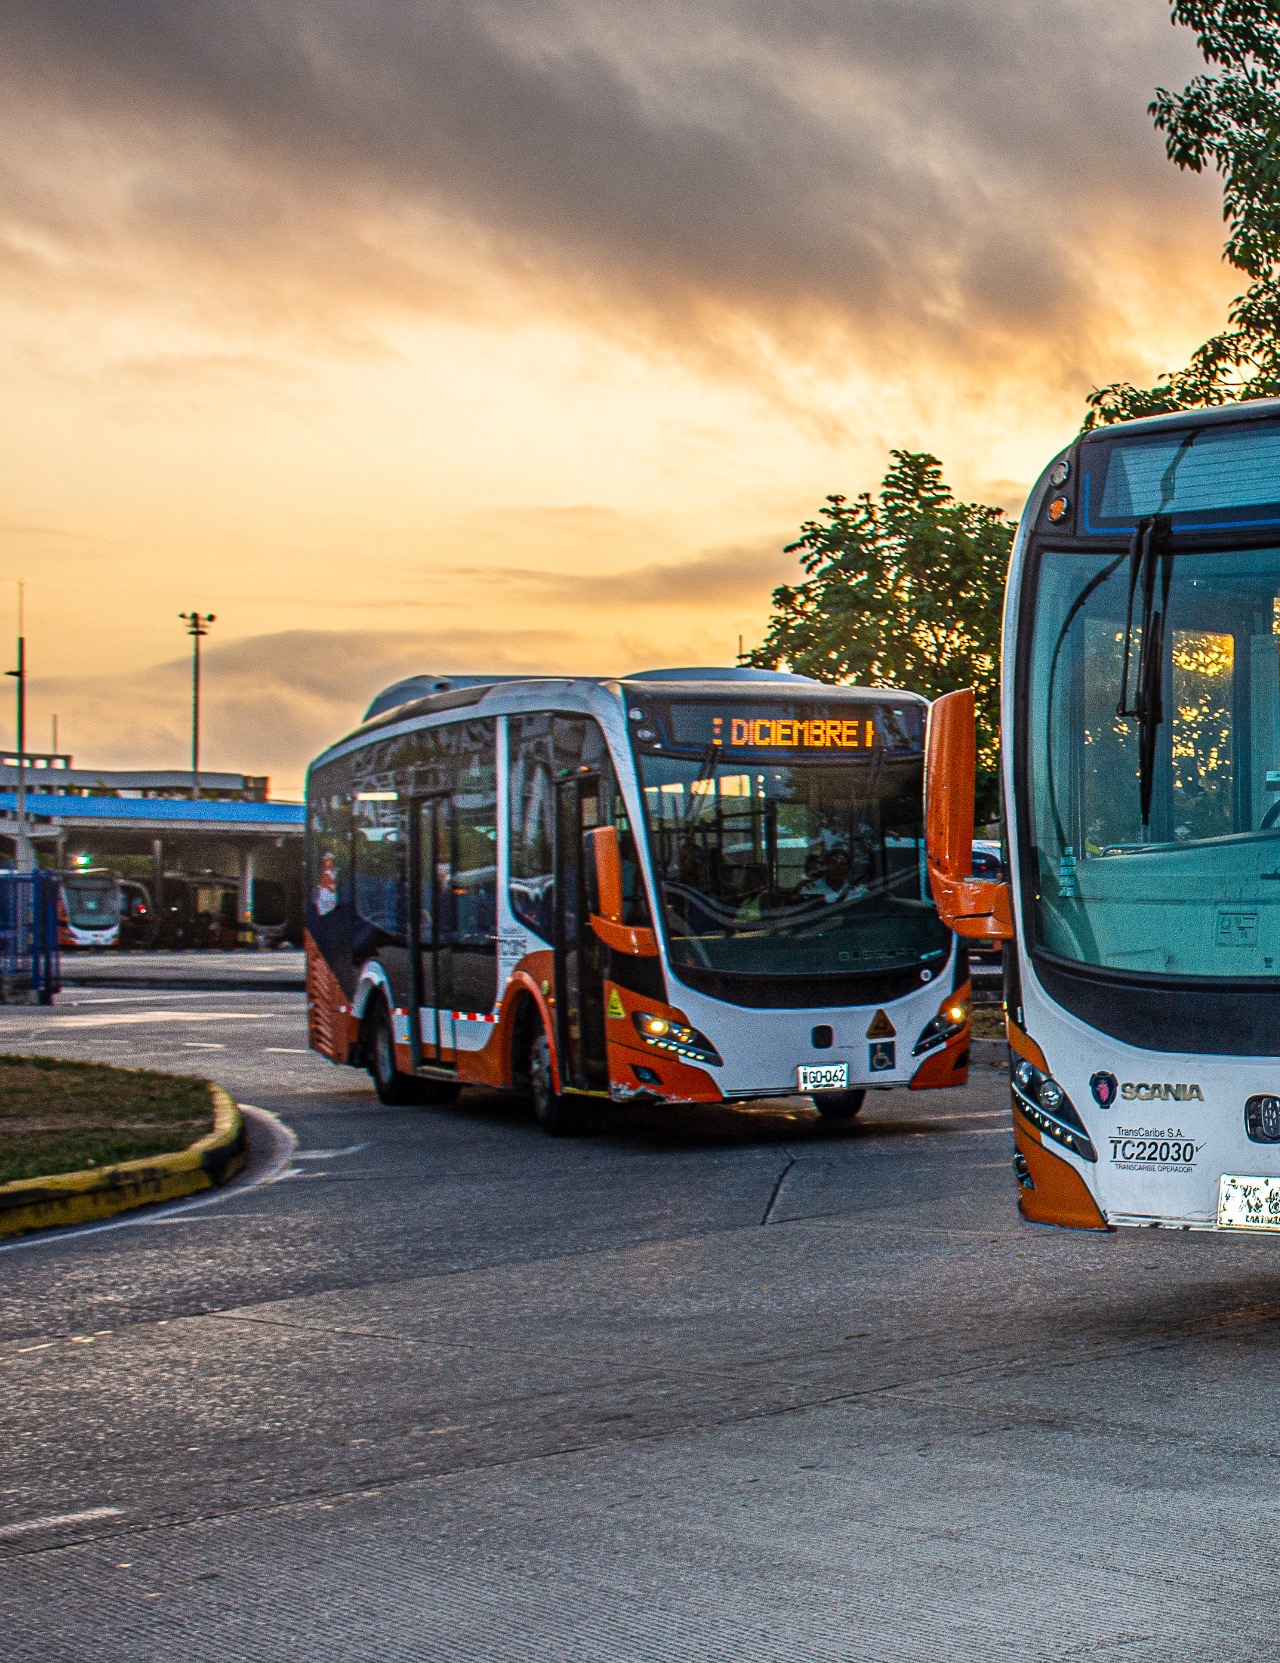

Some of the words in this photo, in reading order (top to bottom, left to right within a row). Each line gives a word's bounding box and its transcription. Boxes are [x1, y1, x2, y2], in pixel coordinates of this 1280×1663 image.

[731, 718, 859, 747] DICIEMBRE
[1120, 1082, 1205, 1102] SCANIA
[1116, 1126, 1166, 1138] TransCaribe
[1167, 1128, 1186, 1138] S.A.
[1109, 1139, 1195, 1163] TC22030
[1115, 1163, 1157, 1172] TRANSCARIBE
[1157, 1165, 1193, 1173] OPERADOR
